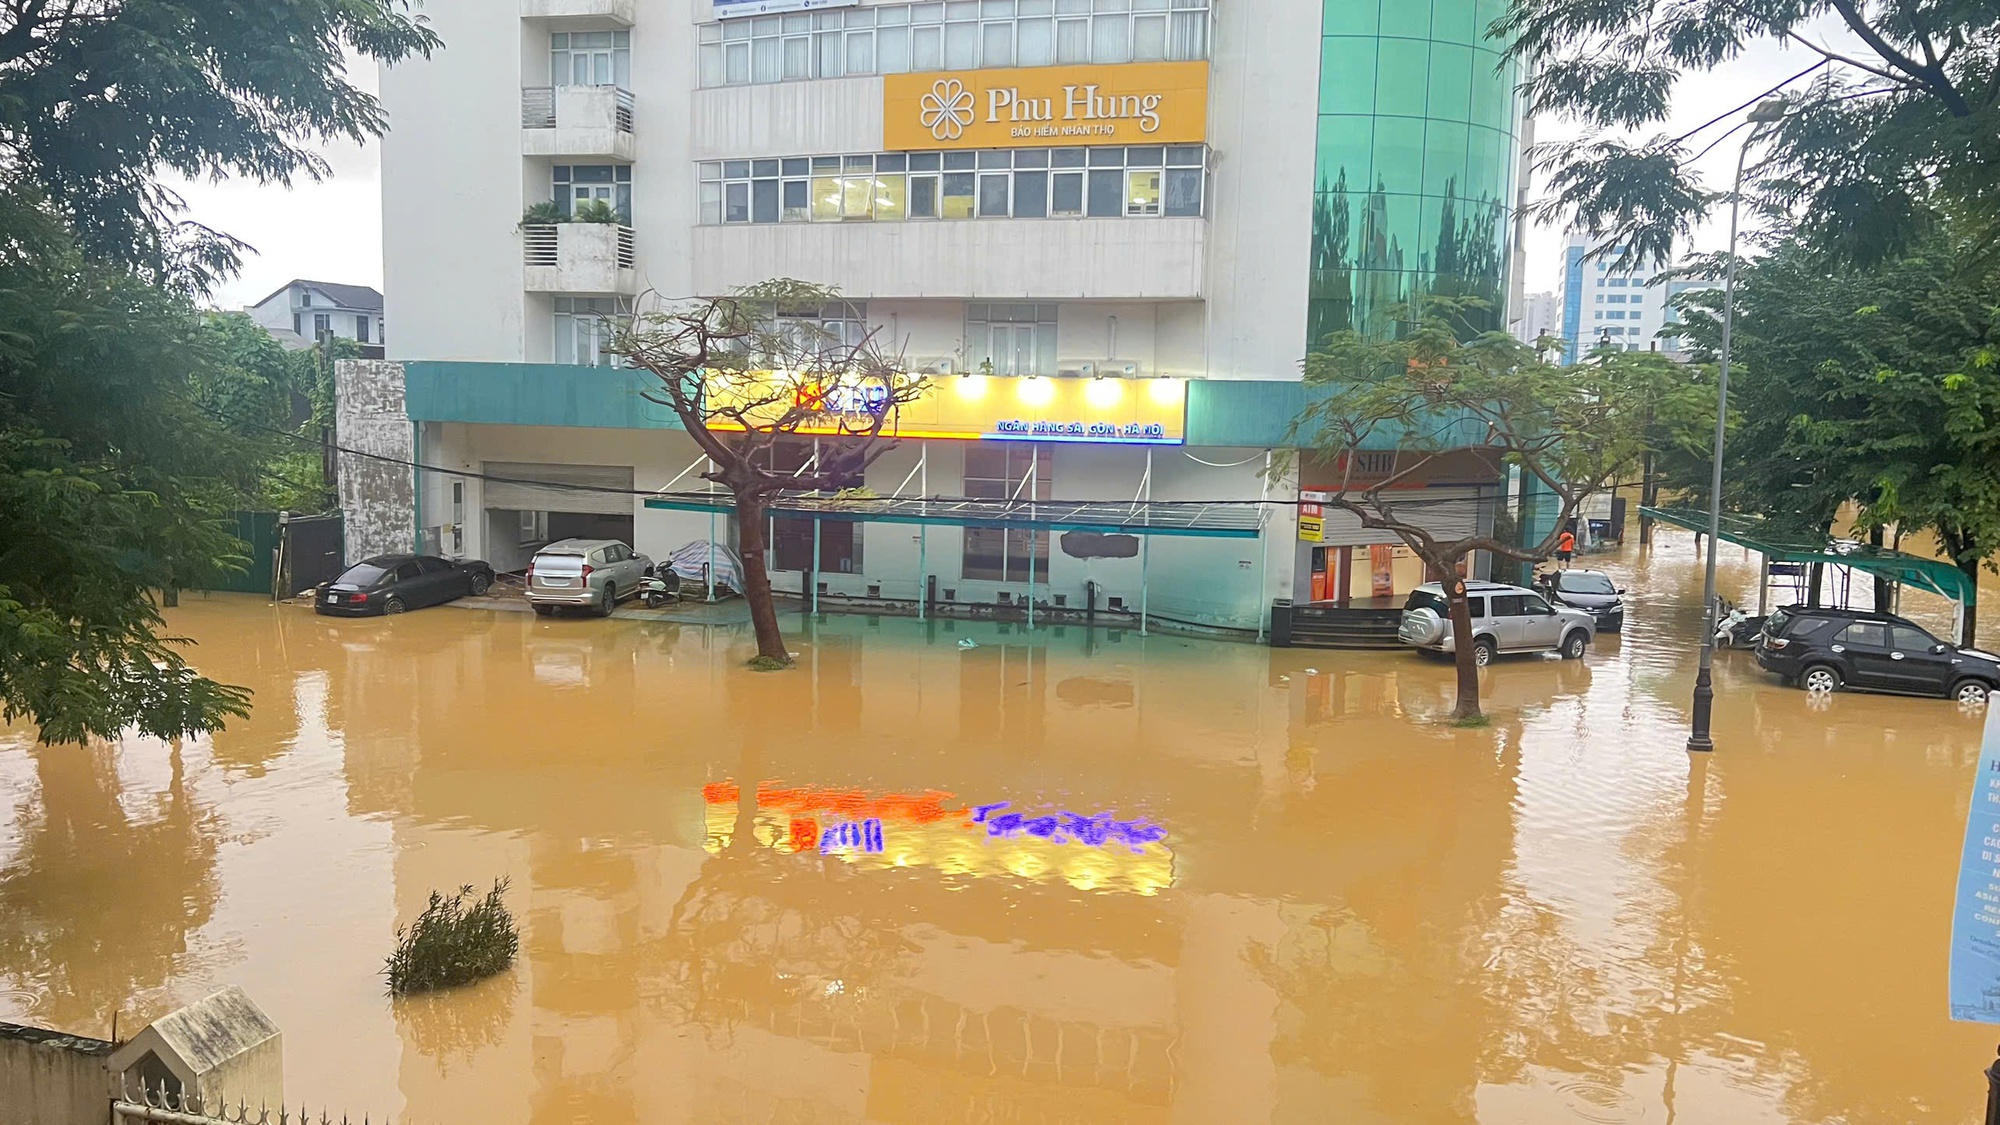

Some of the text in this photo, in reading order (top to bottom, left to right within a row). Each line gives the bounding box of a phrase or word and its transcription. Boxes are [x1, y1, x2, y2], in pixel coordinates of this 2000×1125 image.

[985, 85, 1162, 133] Phu Hung
[1356, 453, 1392, 473] SHB
